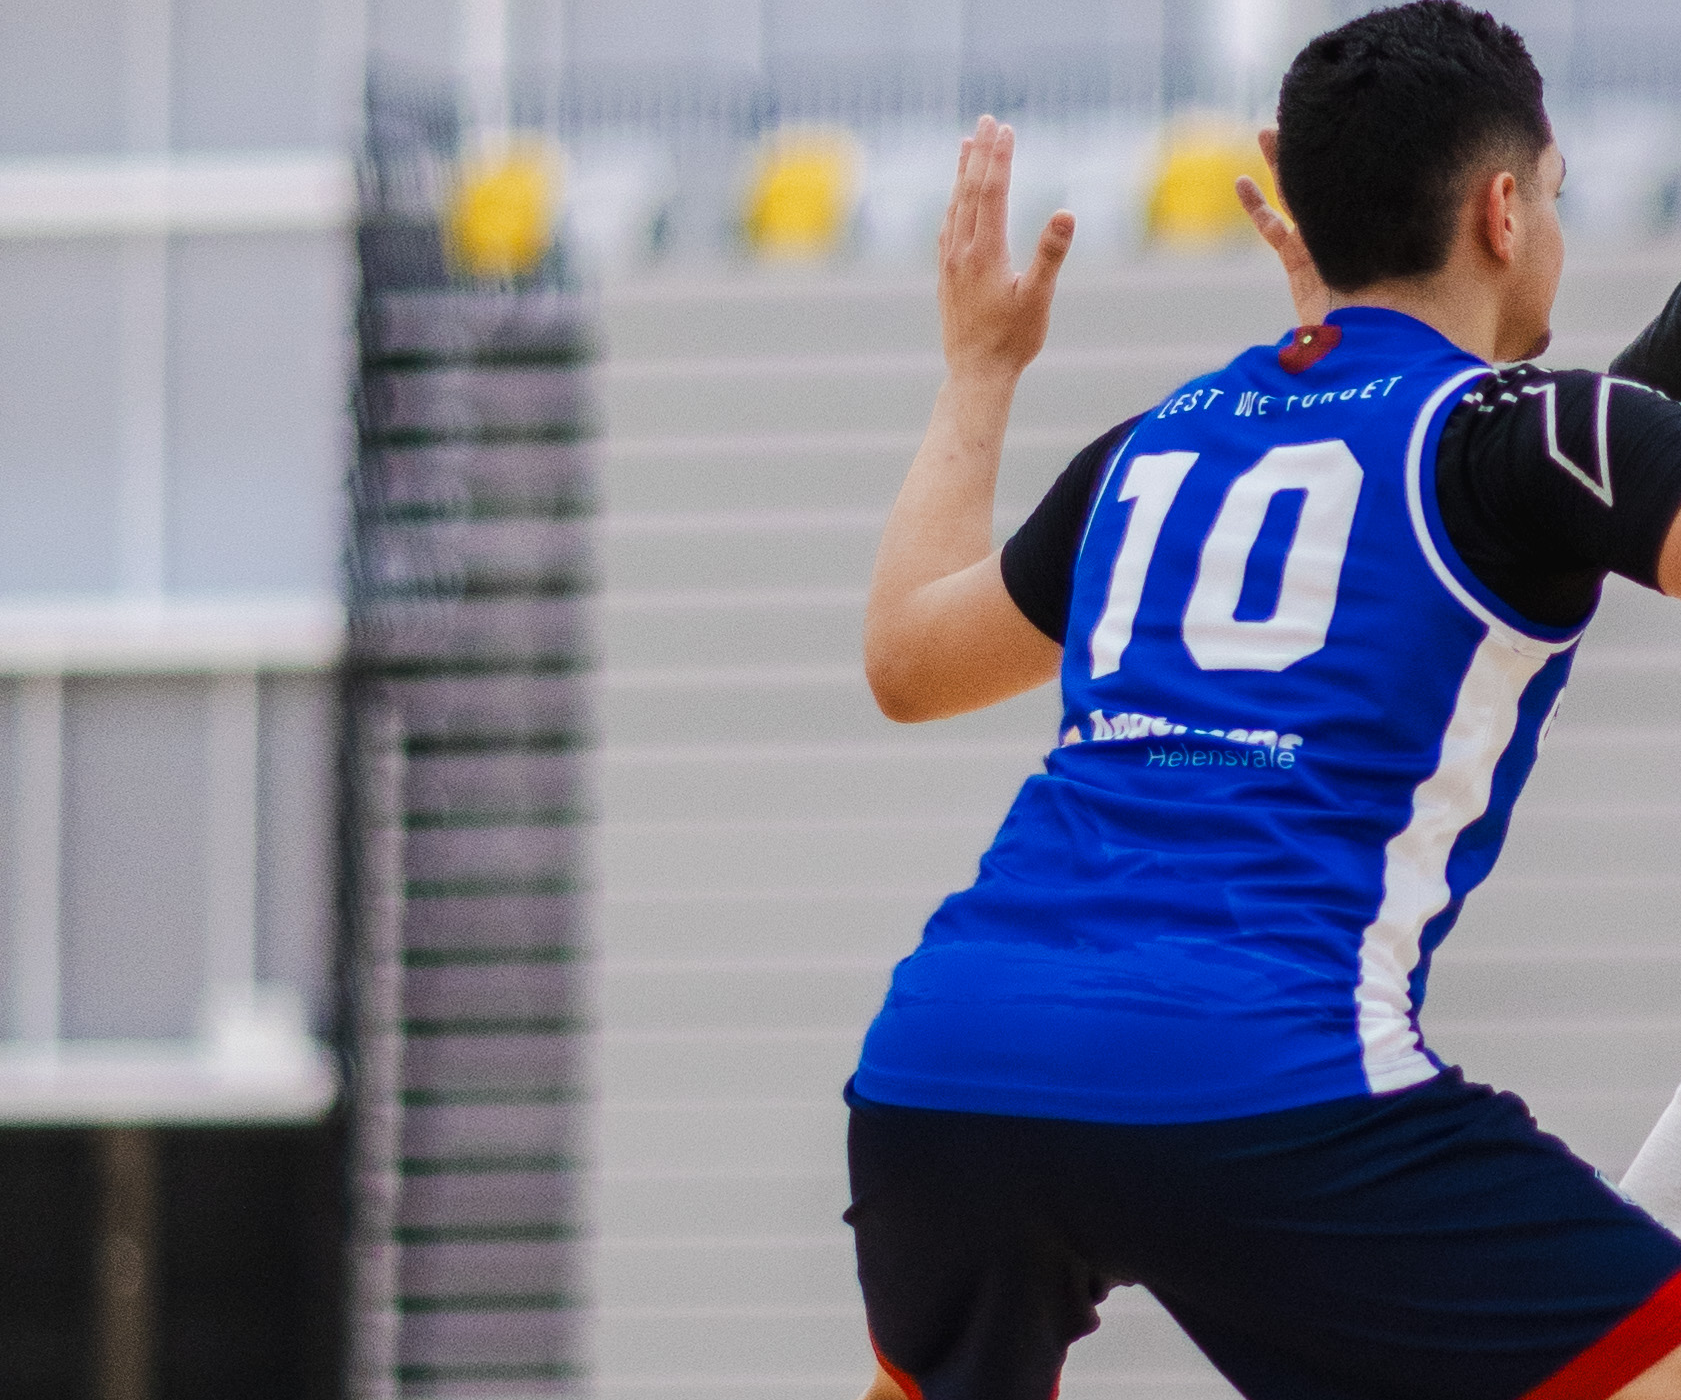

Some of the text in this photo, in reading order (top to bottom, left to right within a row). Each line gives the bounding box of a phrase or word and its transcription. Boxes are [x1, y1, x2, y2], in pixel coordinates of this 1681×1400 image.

[1157, 388, 1225, 420] LEST
[1233, 390, 1275, 418] WE
[1089, 437, 1365, 680] 10
[1145, 744, 1296, 770] Helensvale
